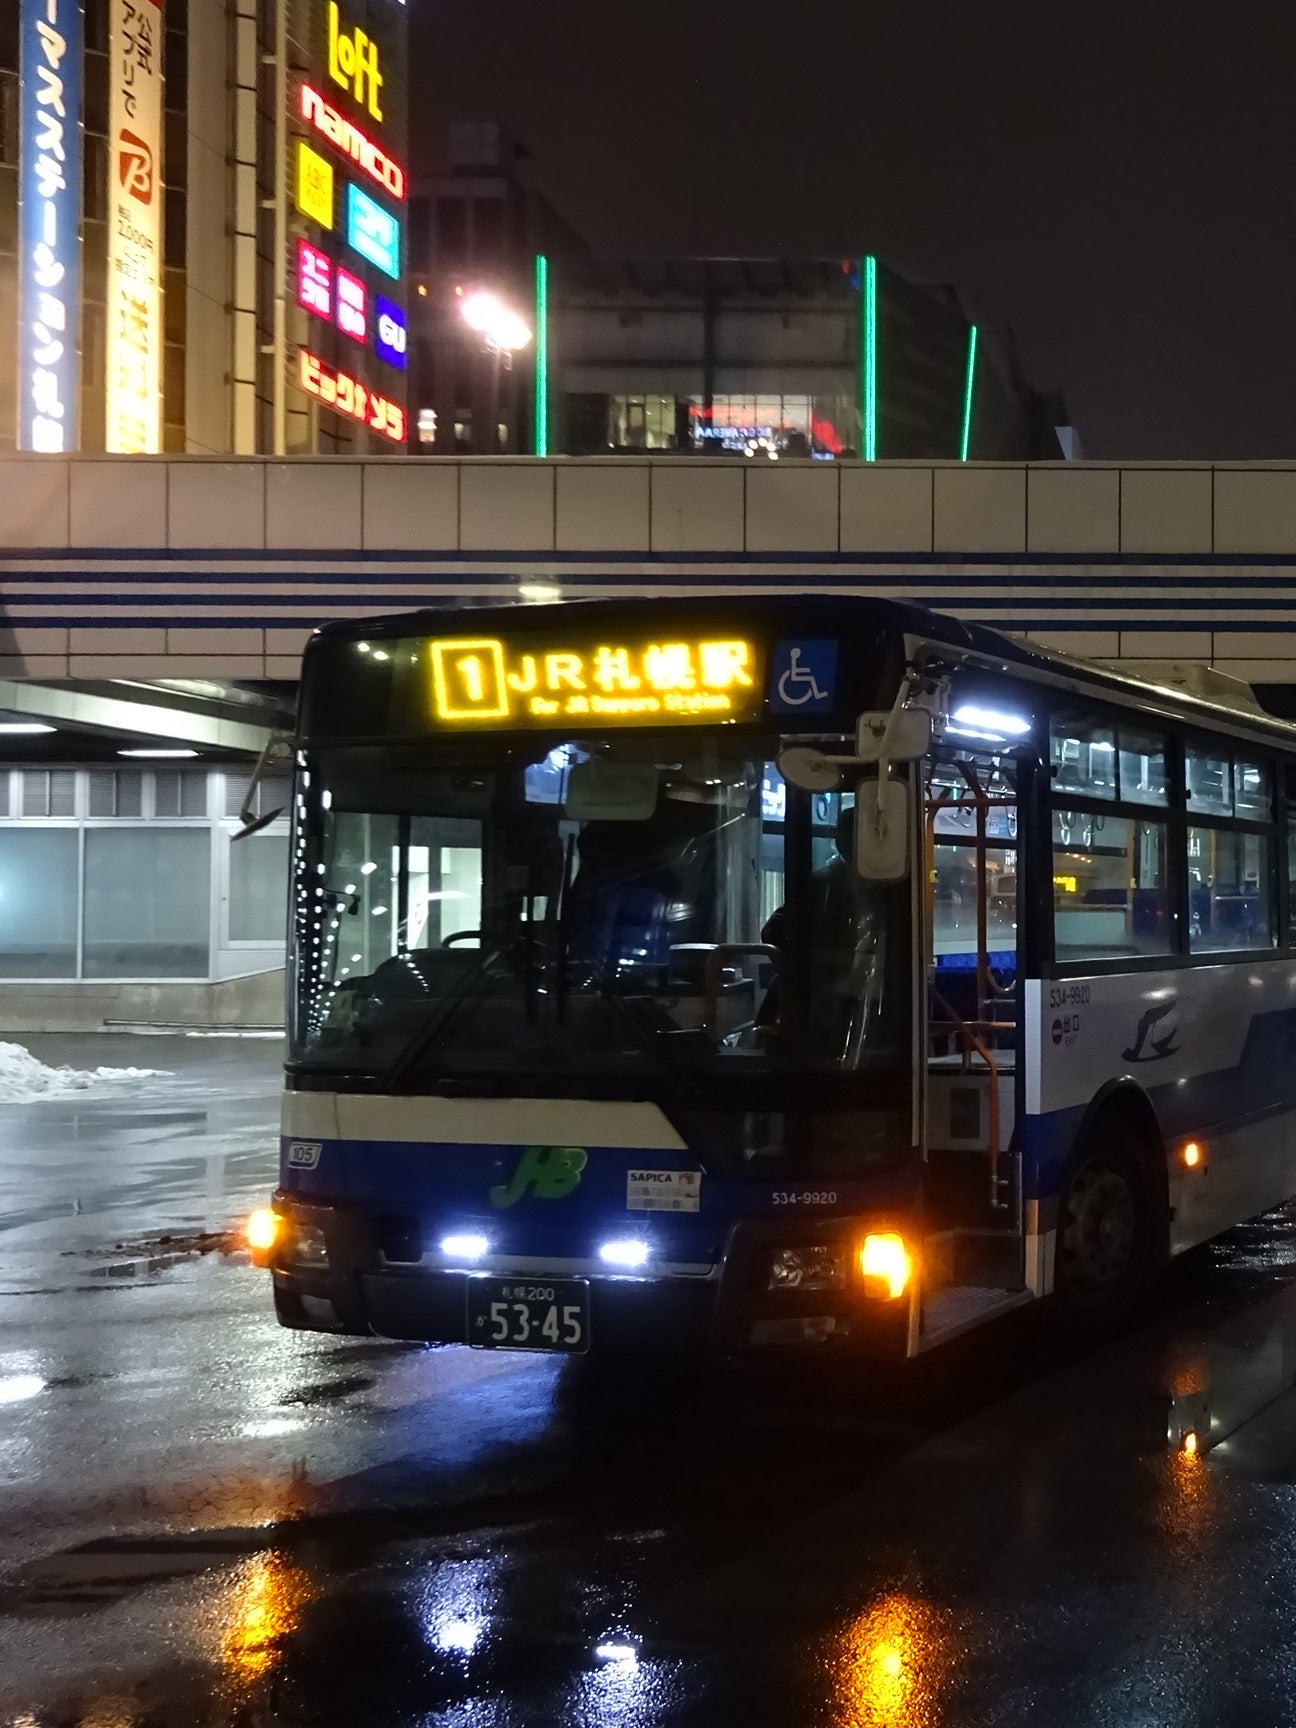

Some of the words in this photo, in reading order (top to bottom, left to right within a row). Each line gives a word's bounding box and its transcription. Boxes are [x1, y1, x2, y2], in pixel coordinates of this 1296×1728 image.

[302, 83, 404, 199] namco
[457, 655, 484, 701] 1
[1050, 985, 1090, 1008] 534-9920
[631, 1173, 672, 1183] SAPICA
[772, 1191, 837, 1205] 534-9920
[490, 1302, 581, 1344] 53-45
